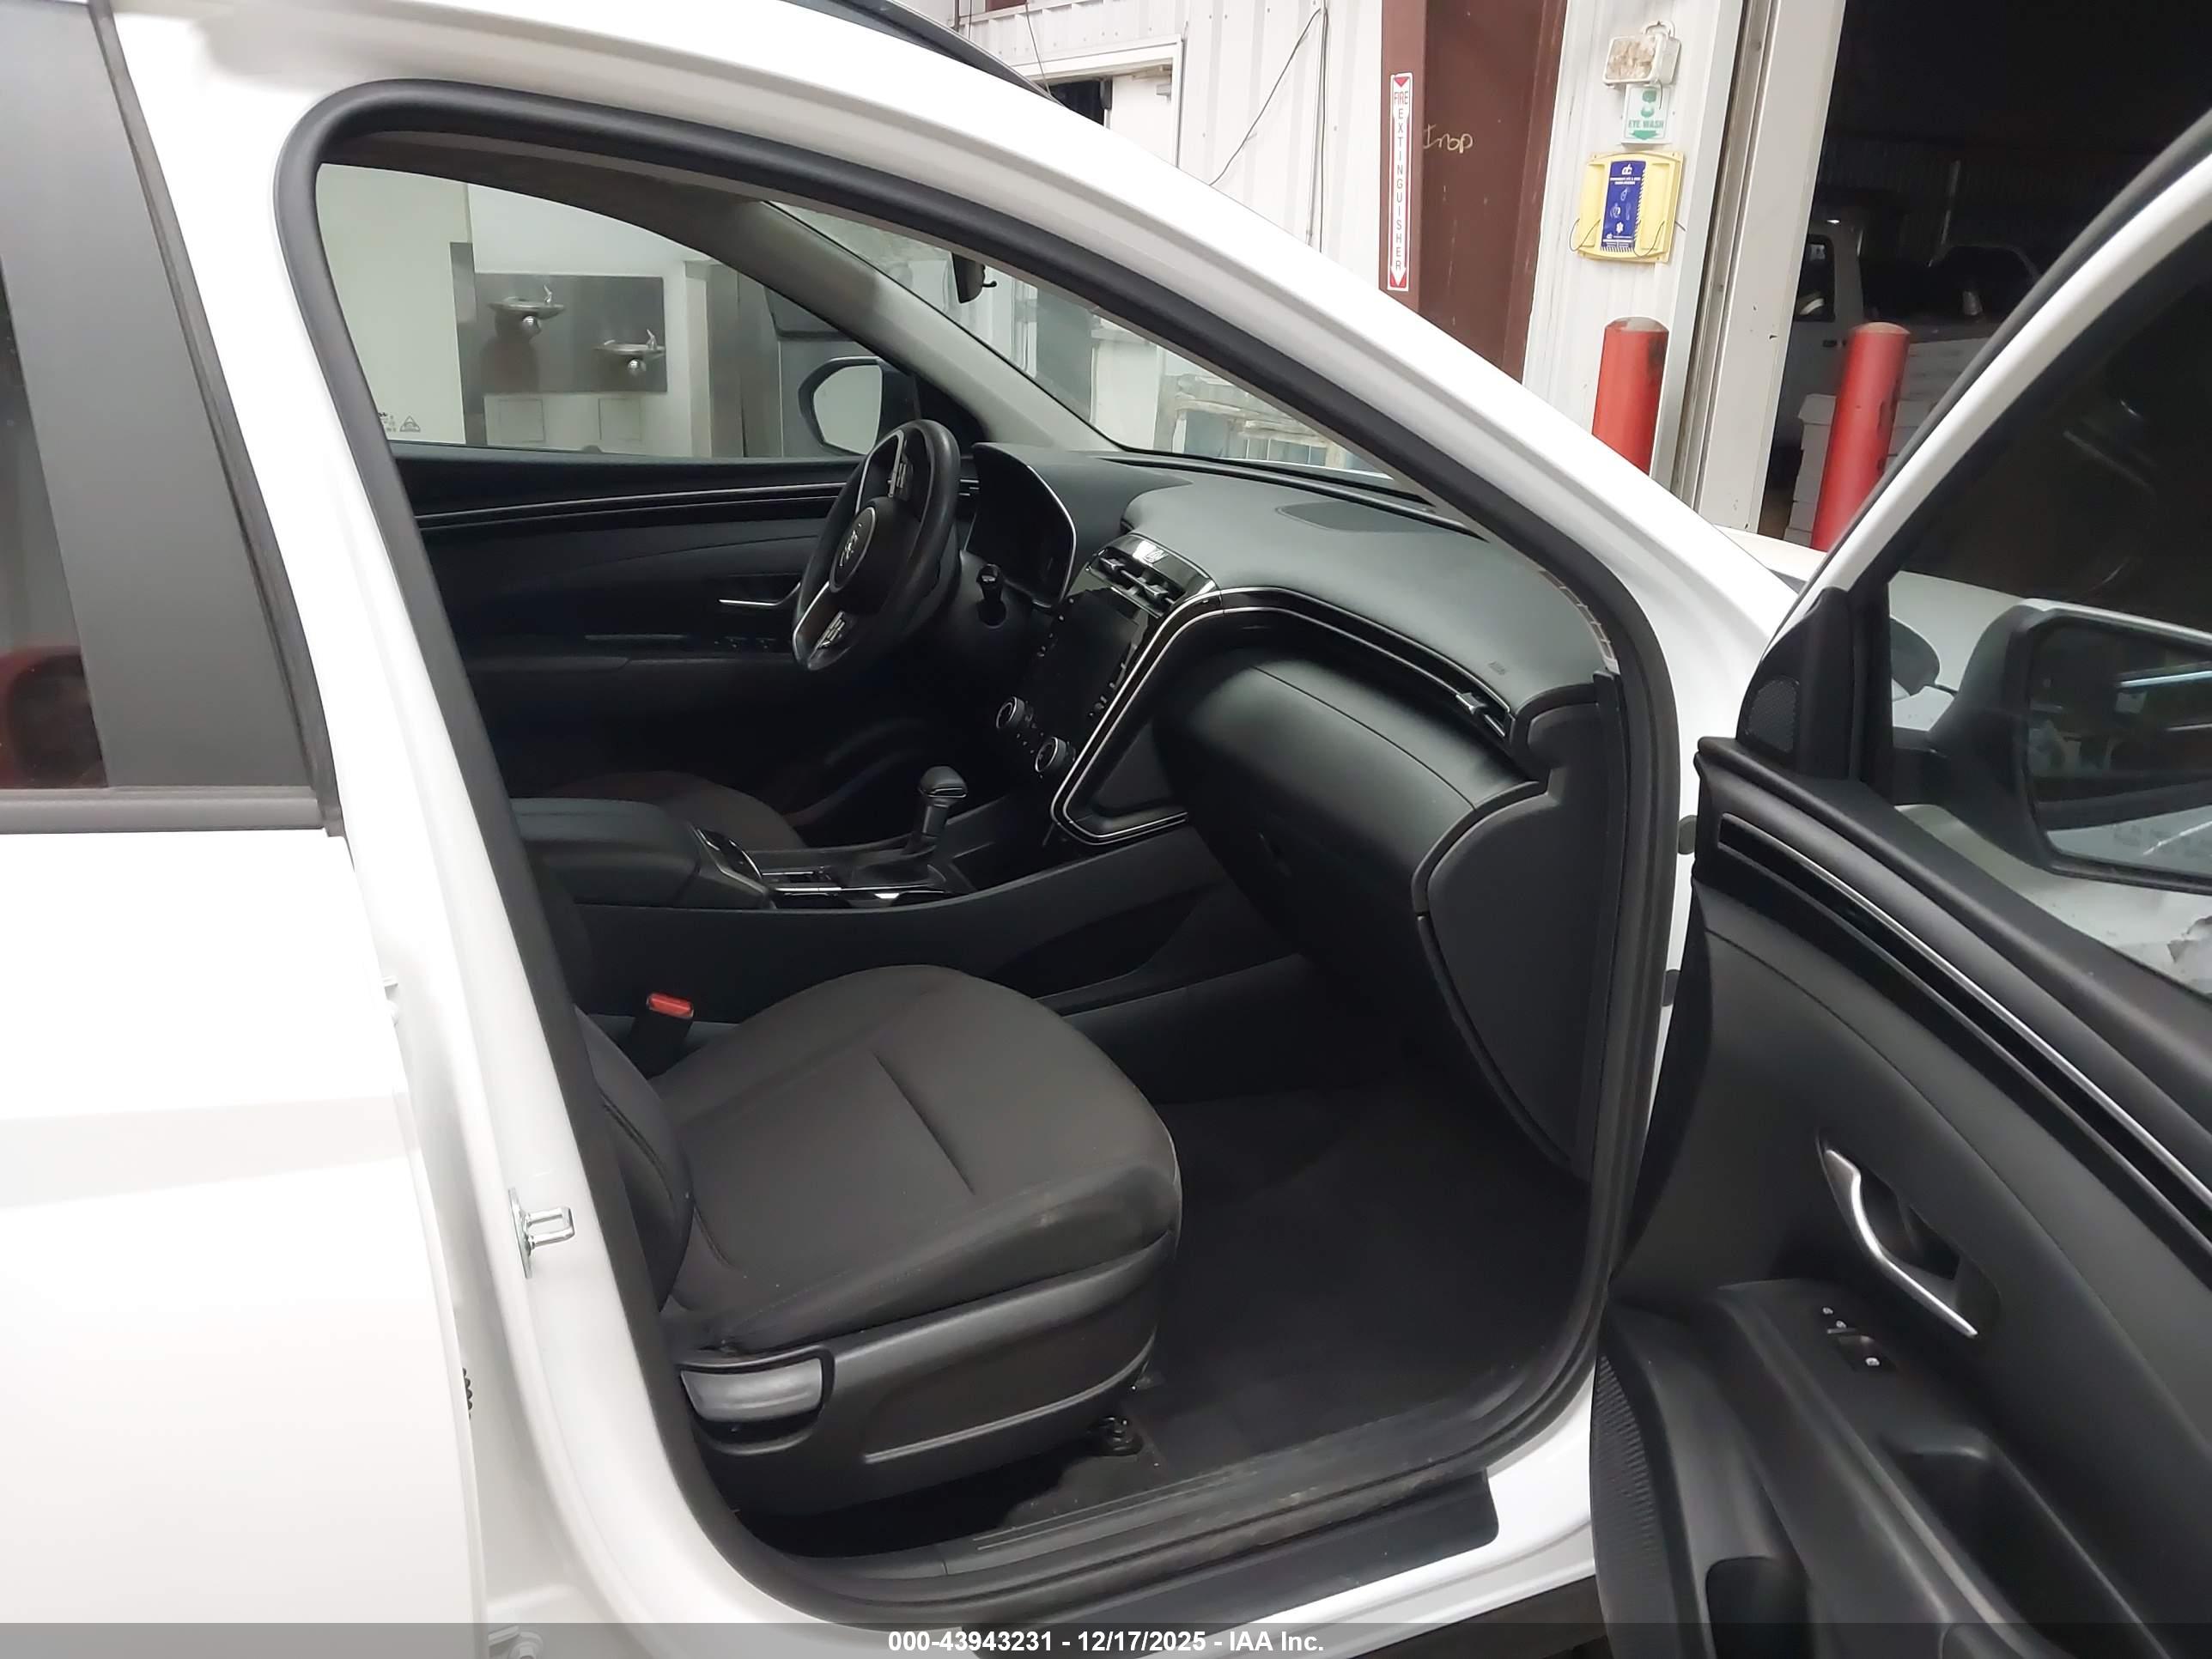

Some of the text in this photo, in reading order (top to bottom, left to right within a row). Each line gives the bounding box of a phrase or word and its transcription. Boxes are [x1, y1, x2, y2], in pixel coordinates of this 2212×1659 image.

[1394, 91, 1408, 105] FIRE
[1628, 119, 1664, 128] EYE WASH
[1395, 108, 1404, 270] EXTINGUISHER
